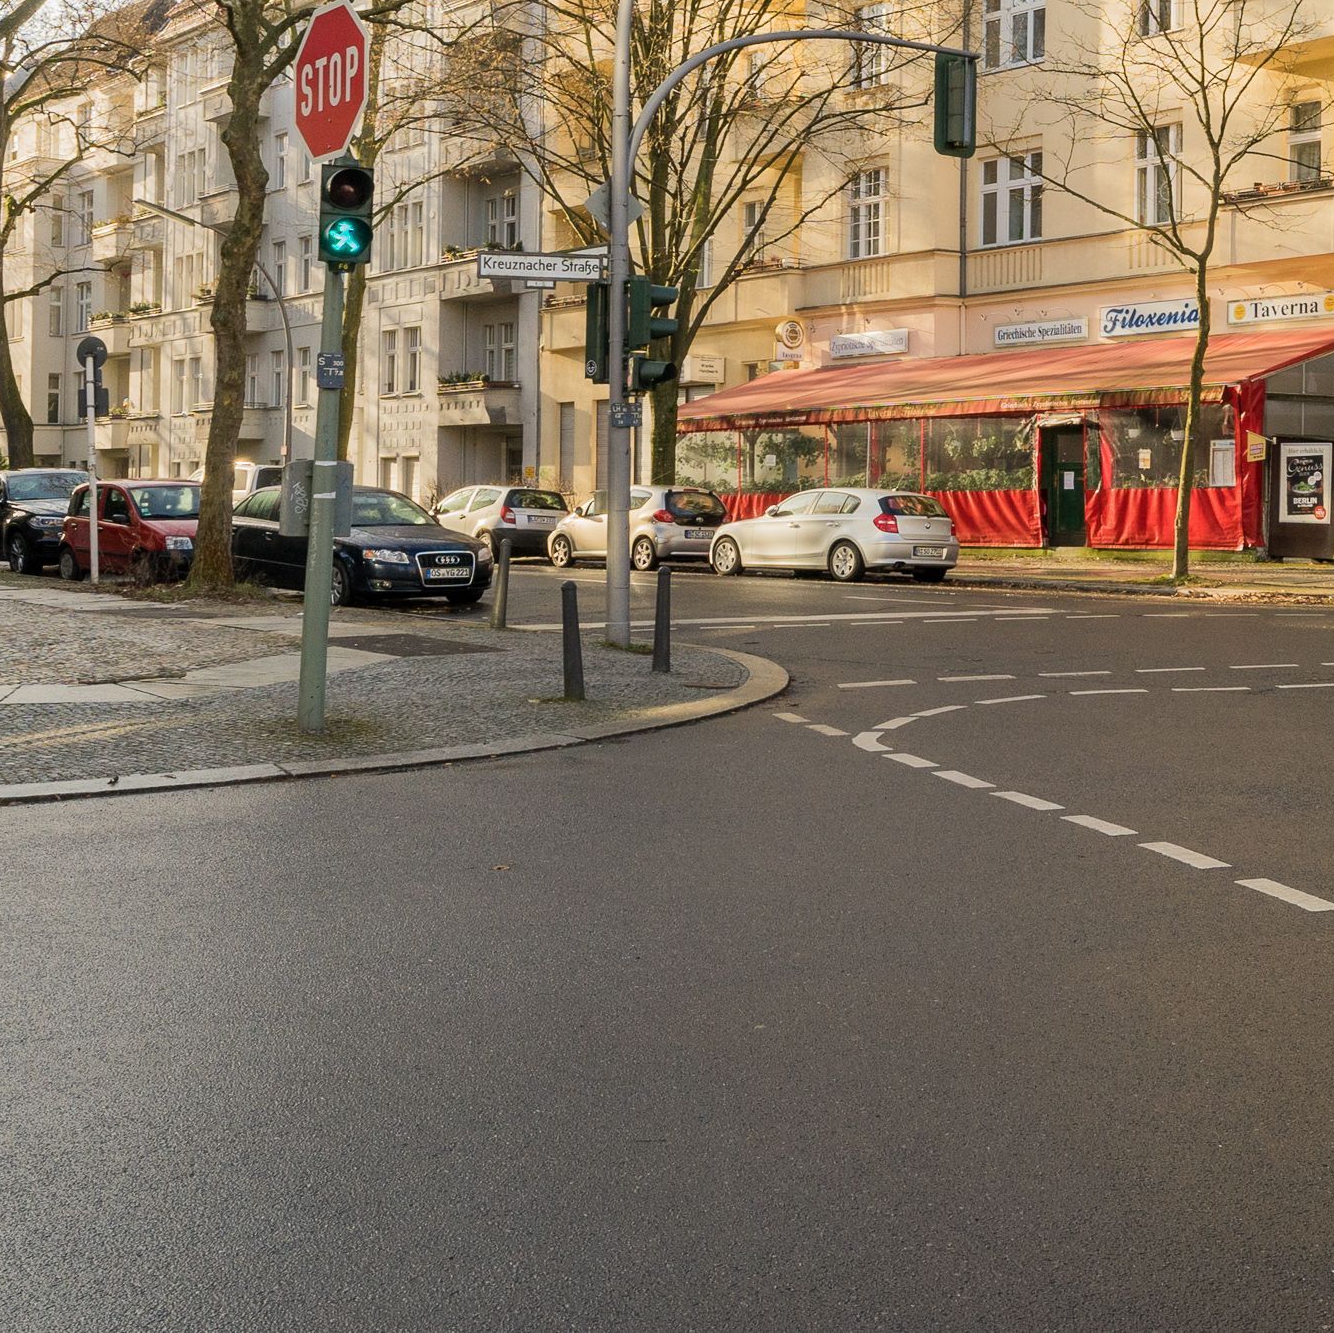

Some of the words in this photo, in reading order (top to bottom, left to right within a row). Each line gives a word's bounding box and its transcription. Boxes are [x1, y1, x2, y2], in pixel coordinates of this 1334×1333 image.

[299, 44, 360, 117] STOP
[482, 256, 558, 272] Kreuznacher
[561, 258, 600, 276] Straße
[1103, 302, 1199, 334] Filoxenia
[1249, 300, 1319, 318] Taverna
[997, 325, 1037, 341] Griechische
[1037, 322, 1083, 339] Spezialitäten
[1293, 497, 1318, 505] BERLIN
[431, 568, 441, 577] OS
[445, 568, 456, 576] YG
[456, 568, 469, 576] 221
